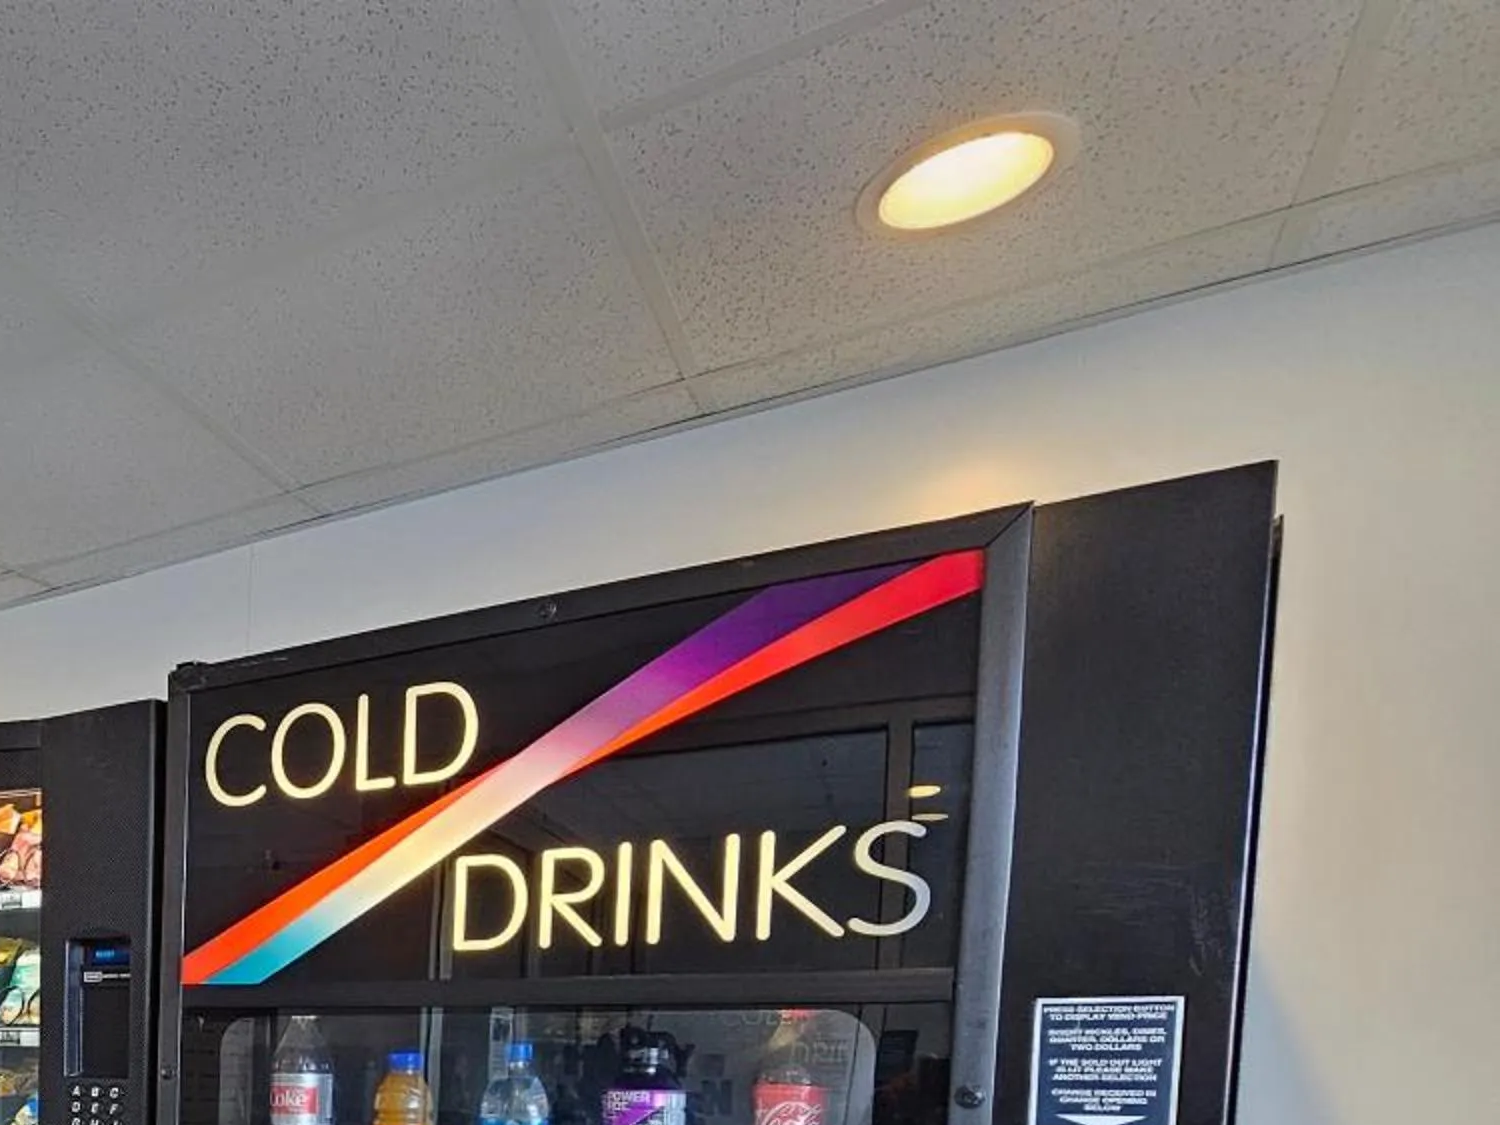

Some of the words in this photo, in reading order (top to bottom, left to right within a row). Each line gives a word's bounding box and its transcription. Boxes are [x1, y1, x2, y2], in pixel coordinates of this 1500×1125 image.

[204, 680, 480, 808] COLD
[452, 819, 931, 951] DRINKS
[1076, 1005, 1131, 1013] SELECTION
[1133, 1004, 1174, 1012] BUTTON
[1100, 1035, 1147, 1043] DOLLARS
[1071, 1043, 1092, 1051] TWO
[1095, 1043, 1142, 1051] DOLLARS
[1110, 1059, 1130, 1067] OUT
[1132, 1059, 1162, 1067] LIGHT
[1052, 1073, 1098, 1081] ANOTHER
[72, 1086, 80, 1096] A
